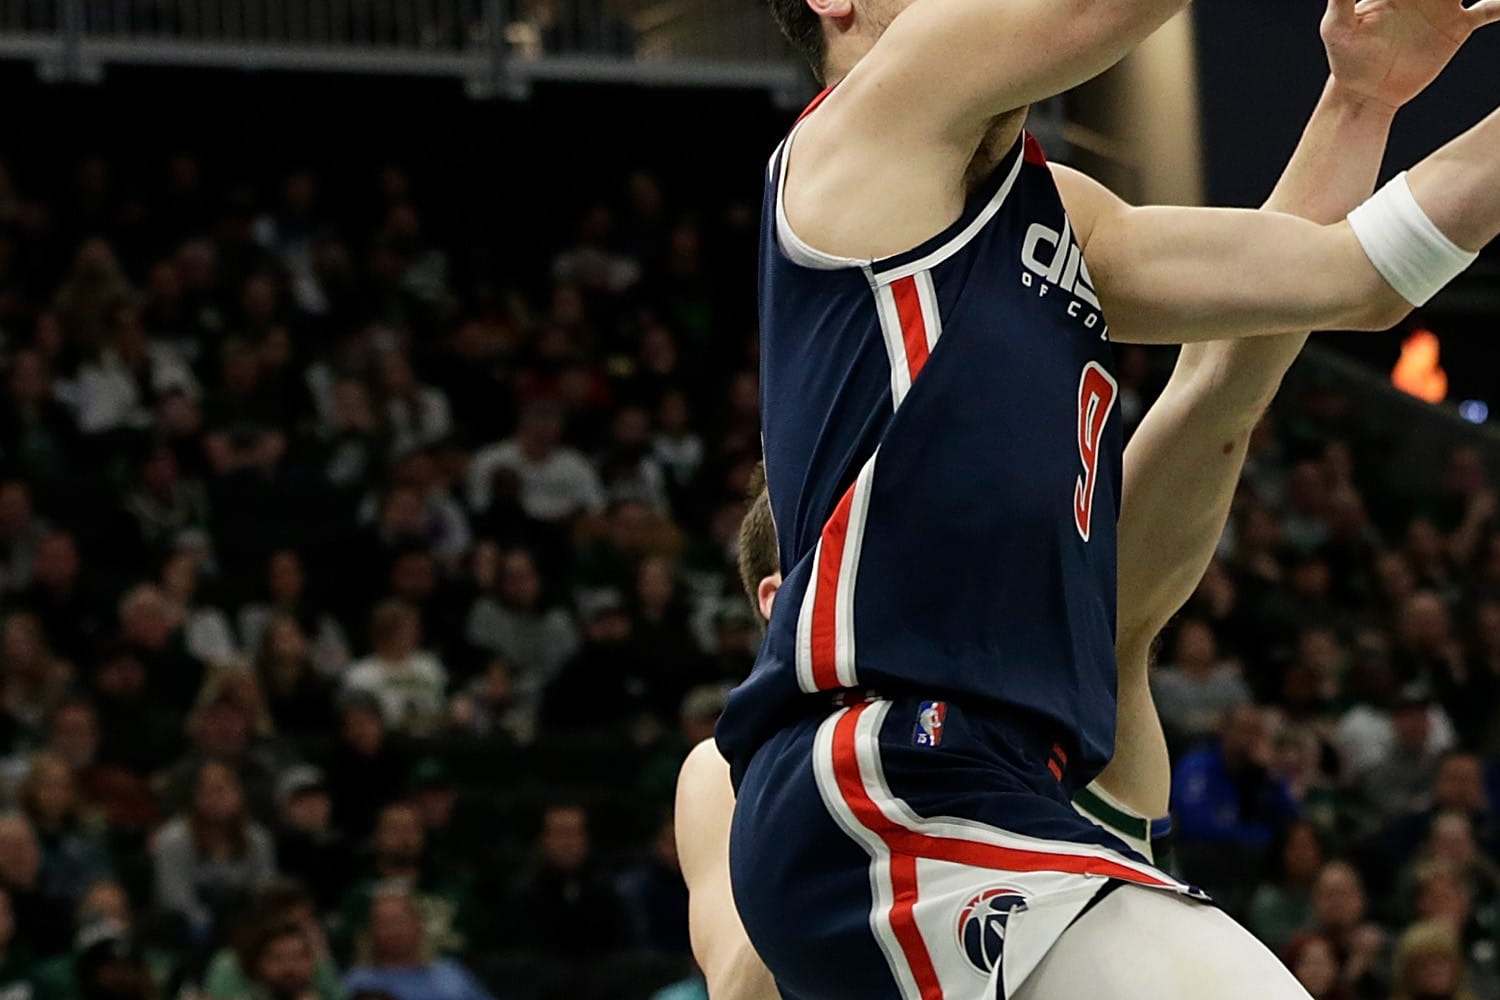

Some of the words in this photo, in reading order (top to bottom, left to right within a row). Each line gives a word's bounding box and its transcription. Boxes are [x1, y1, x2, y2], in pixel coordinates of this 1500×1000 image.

[1022, 271, 1048, 297] OF
[1067, 300, 1108, 341] COL
[1074, 360, 1118, 542] 9
